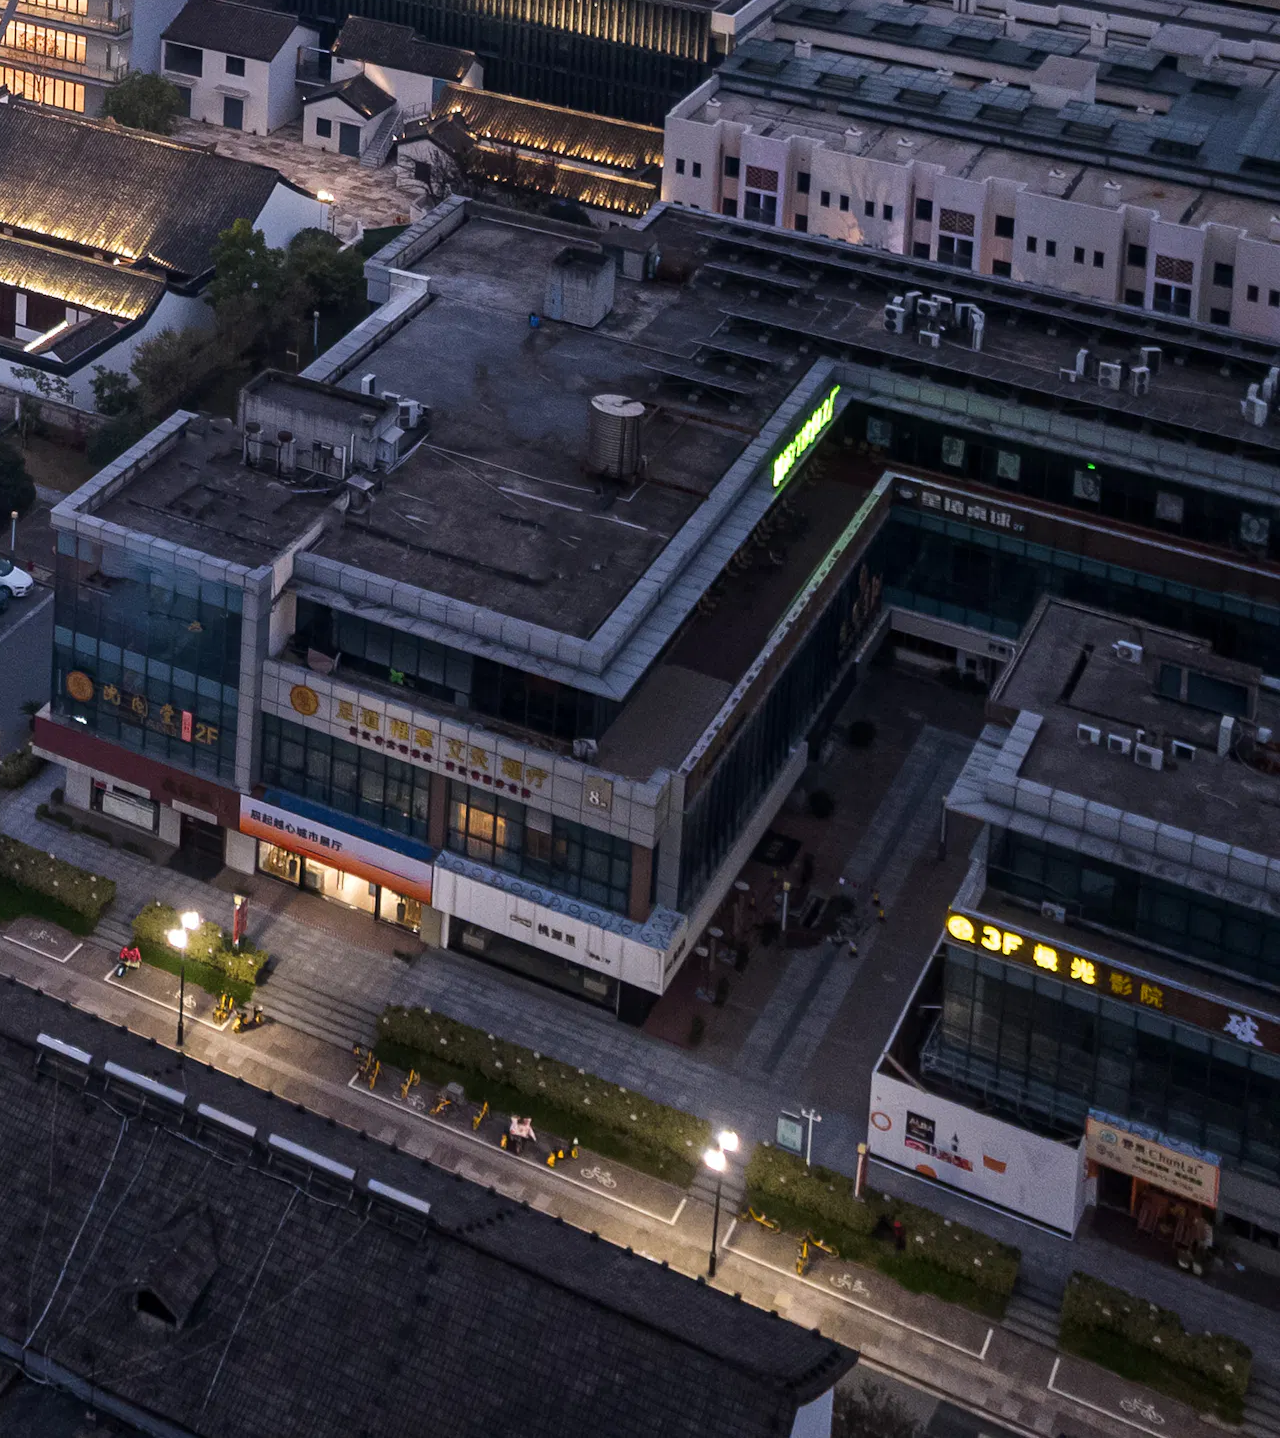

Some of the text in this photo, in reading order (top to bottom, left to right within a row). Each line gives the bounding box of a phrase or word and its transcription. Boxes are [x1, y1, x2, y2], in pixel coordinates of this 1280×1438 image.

[195, 722, 219, 745] 2F
[335, 699, 381, 732] 足道
[501, 755, 548, 789] 理疗
[980, 924, 1024, 956] 3F
